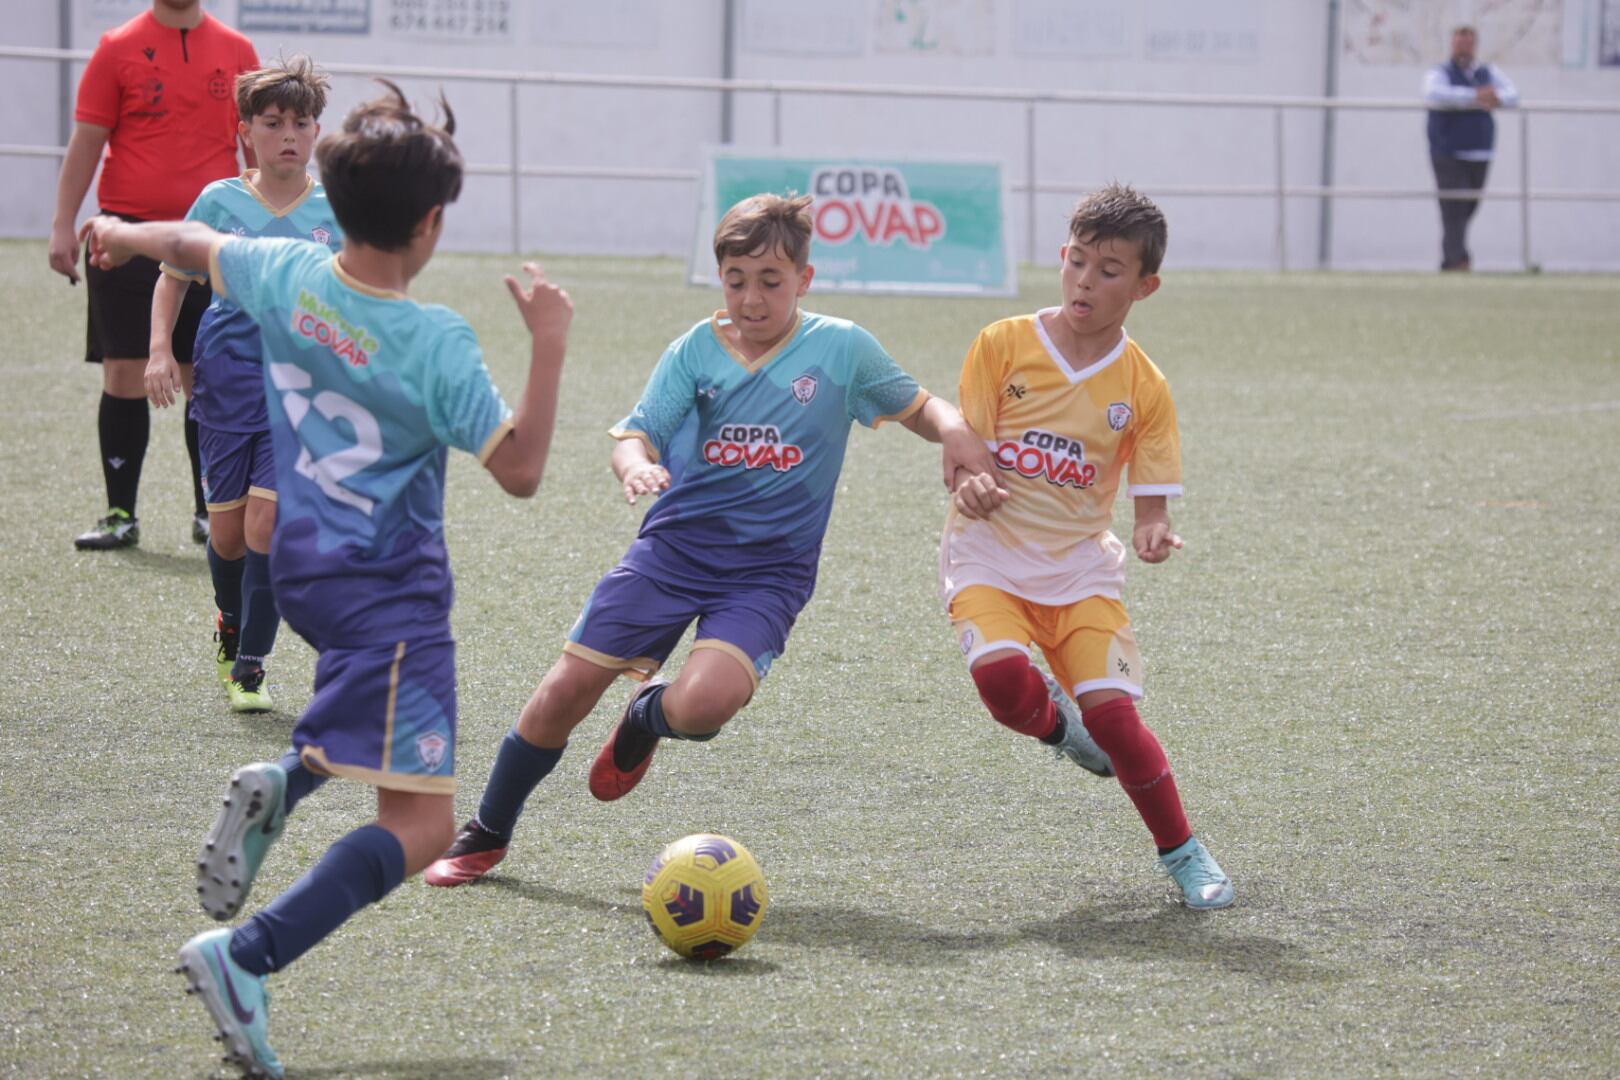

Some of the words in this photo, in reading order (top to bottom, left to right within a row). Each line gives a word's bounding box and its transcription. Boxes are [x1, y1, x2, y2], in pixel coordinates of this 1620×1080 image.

[815, 171, 903, 197] COPA
[809, 200, 944, 245] OVAP
[295, 311, 369, 367] COVAP
[721, 427, 779, 443] COPA
[1023, 430, 1082, 460] COPA
[703, 440, 803, 470] COVAP
[995, 441, 1097, 487] COVAP
